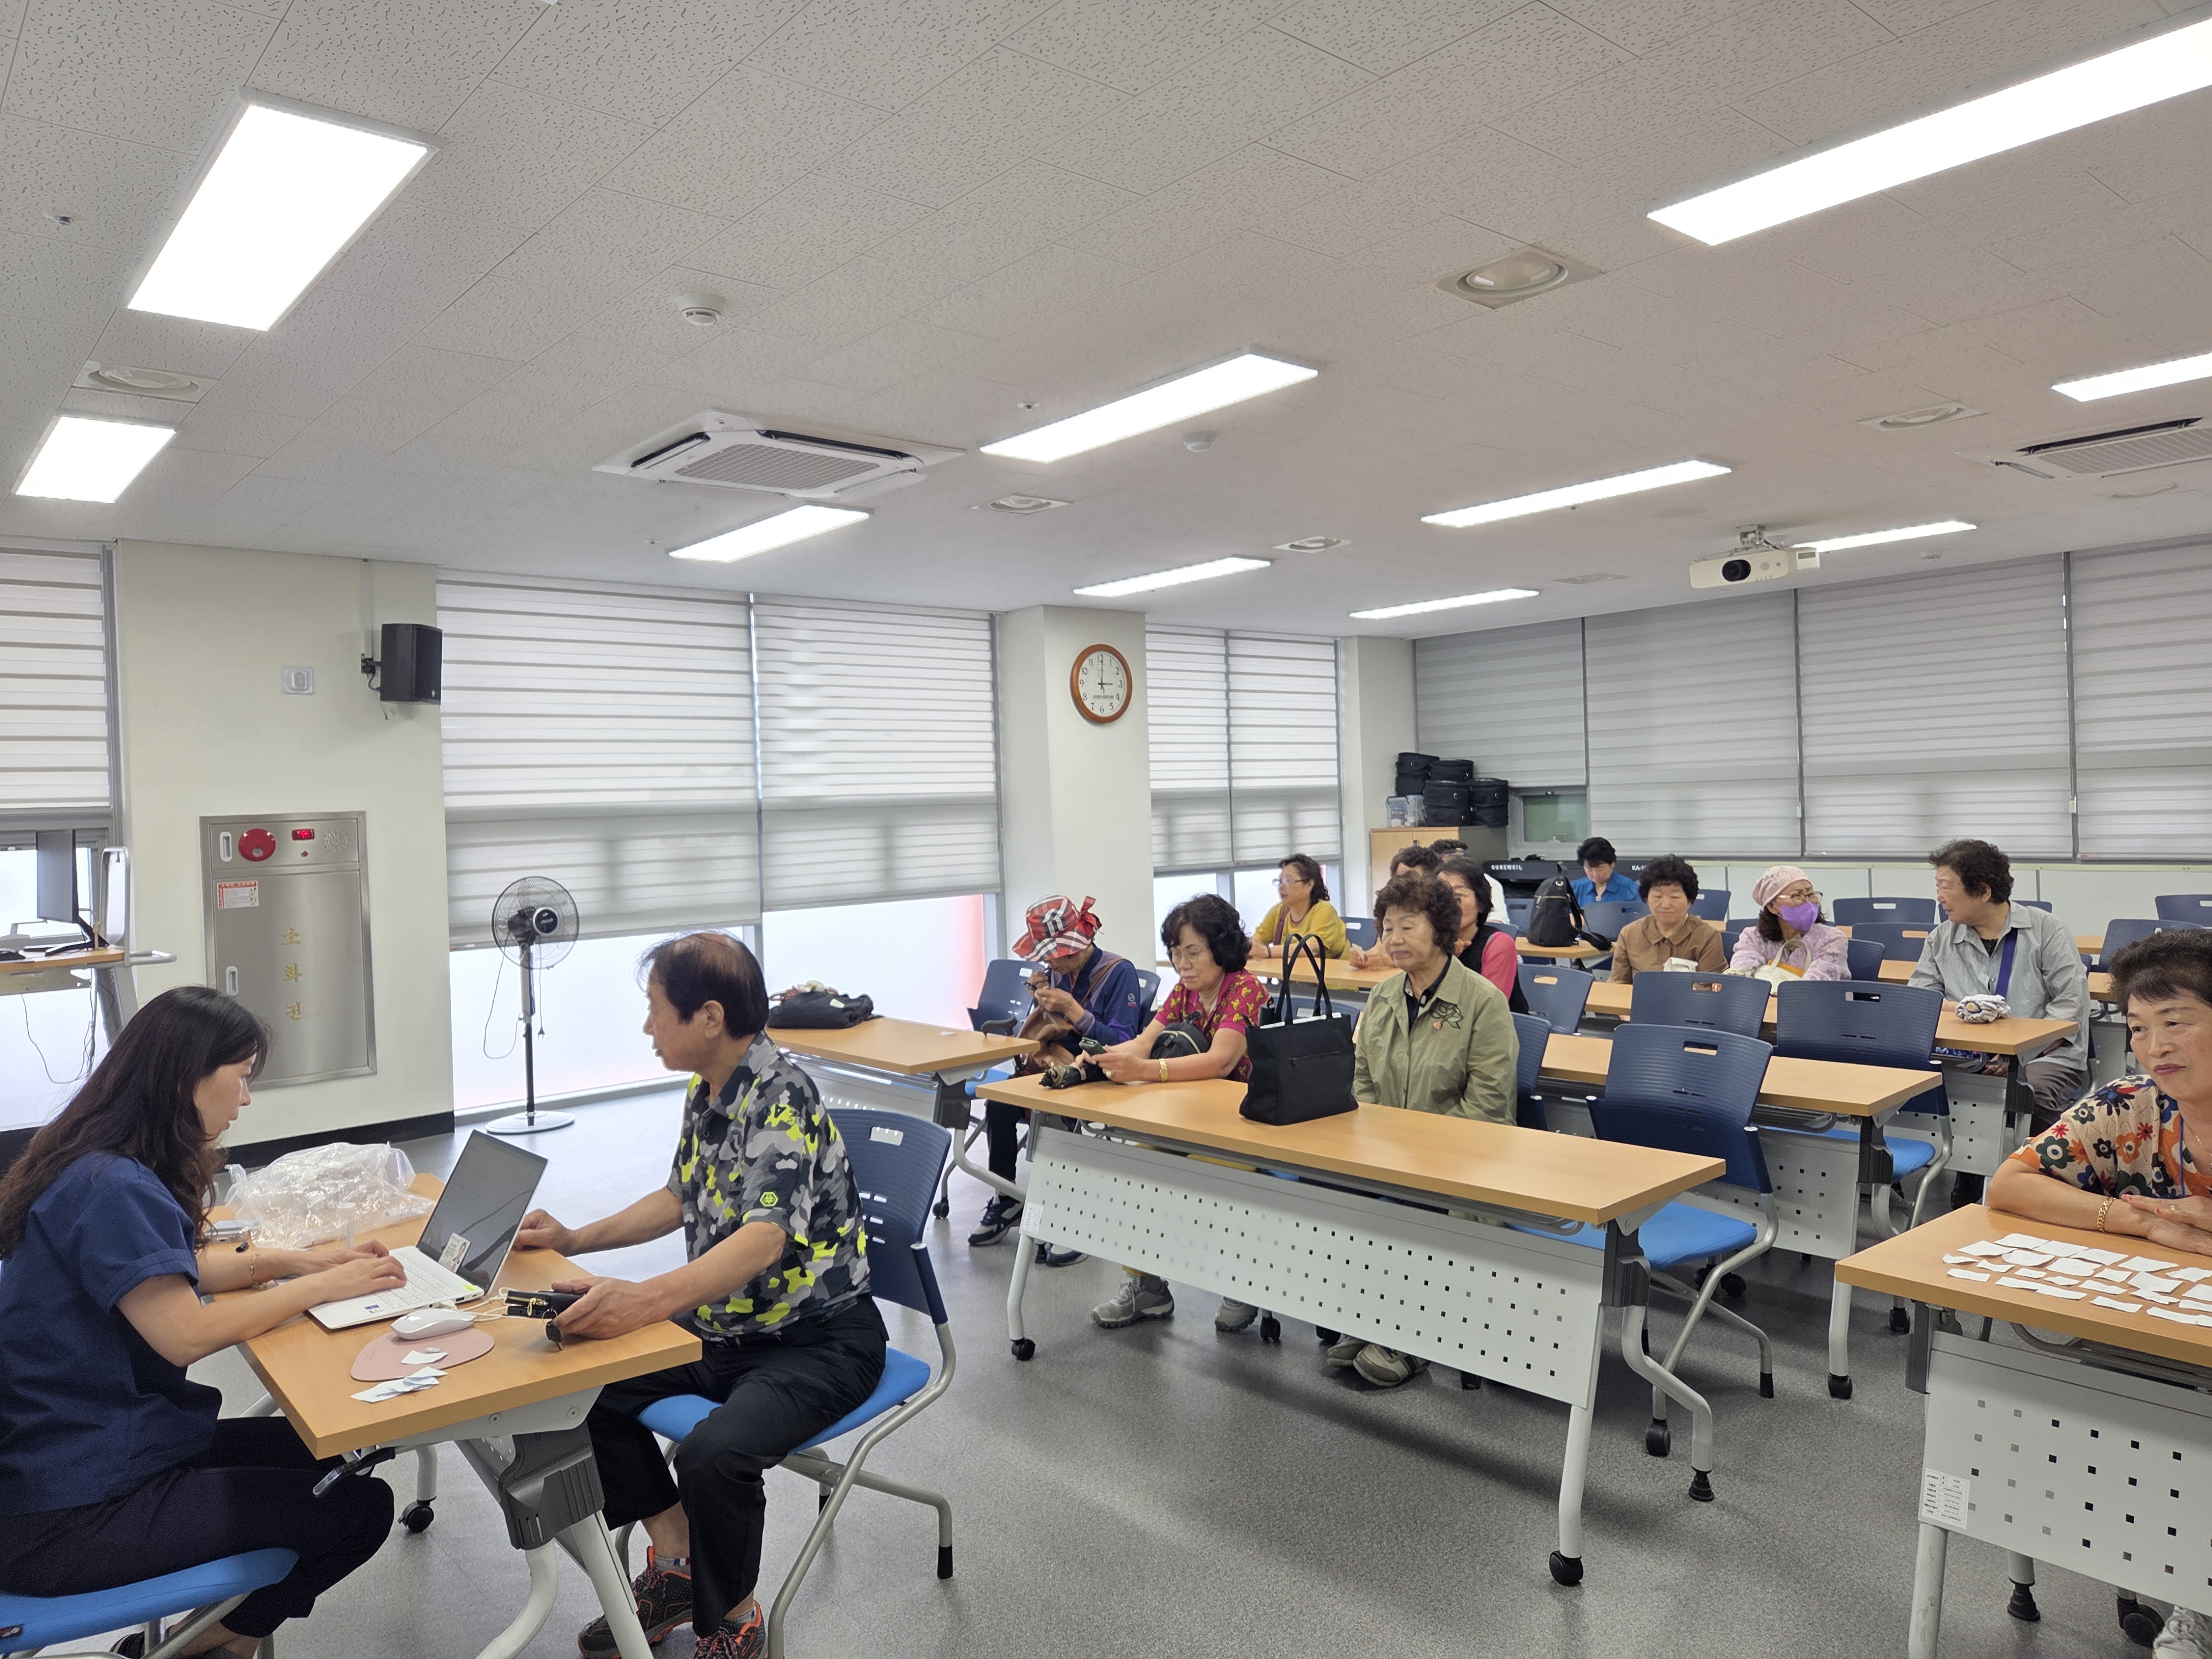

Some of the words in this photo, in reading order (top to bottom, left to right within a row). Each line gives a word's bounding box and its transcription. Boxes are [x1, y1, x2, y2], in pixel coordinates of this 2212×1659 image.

[1088, 658, 1093, 667] 11
[1097, 654, 1104, 663] 12
[1109, 658, 1112, 667] 1
[1082, 667, 1088, 675] 10
[1115, 666, 1119, 675] 2
[1079, 679, 1084, 687] 9
[1118, 680, 1123, 688] 3
[1082, 692, 1088, 701] 8
[1115, 693, 1120, 701] 4
[1091, 702, 1095, 711] 7
[1099, 705, 1104, 713] 6
[281, 927, 302, 1021] 소화전
